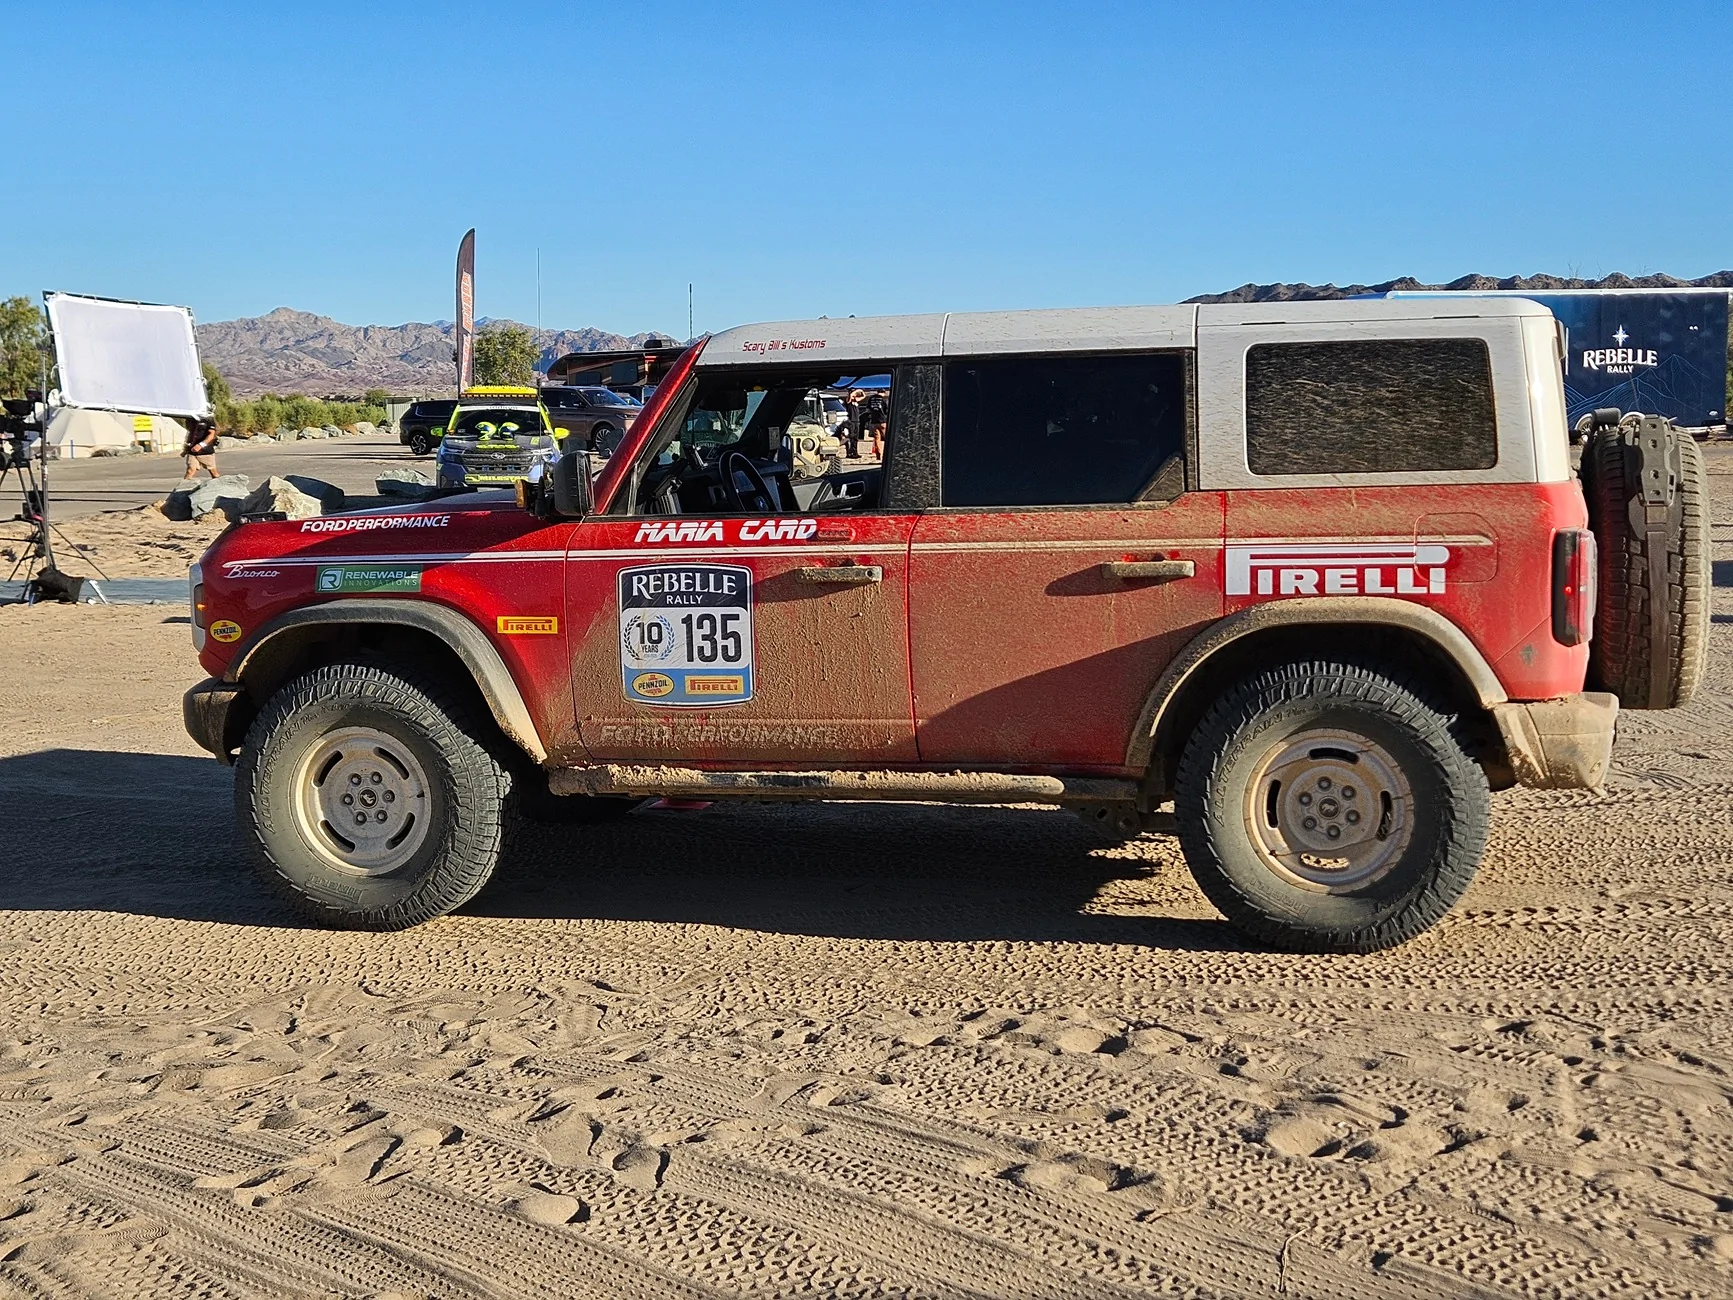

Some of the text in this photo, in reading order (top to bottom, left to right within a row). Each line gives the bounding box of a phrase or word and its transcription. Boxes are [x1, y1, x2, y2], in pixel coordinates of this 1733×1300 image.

[742, 339, 826, 355] Scary Bill's Kustoms
[1583, 348, 1658, 370] REBELLE
[1607, 365, 1634, 374] RALLY
[634, 521, 724, 543] MARIA
[739, 519, 817, 541] CARD
[223, 564, 281, 579] Bronco
[346, 570, 419, 580] RENEWABLE
[1225, 545, 1450, 595] PIRELLI
[344, 579, 418, 587] INNOVATIONS
[631, 572, 738, 600] REBELLE
[666, 594, 703, 605] RALLY
[213, 626, 239, 636] PENNZOIL
[503, 619, 553, 631] PIRELLI
[635, 621, 663, 645] 10
[681, 613, 742, 663] 135
[641, 644, 659, 654] YEARS
[638, 679, 668, 690] PENNZOIL
[689, 679, 739, 691] PIRELLI
